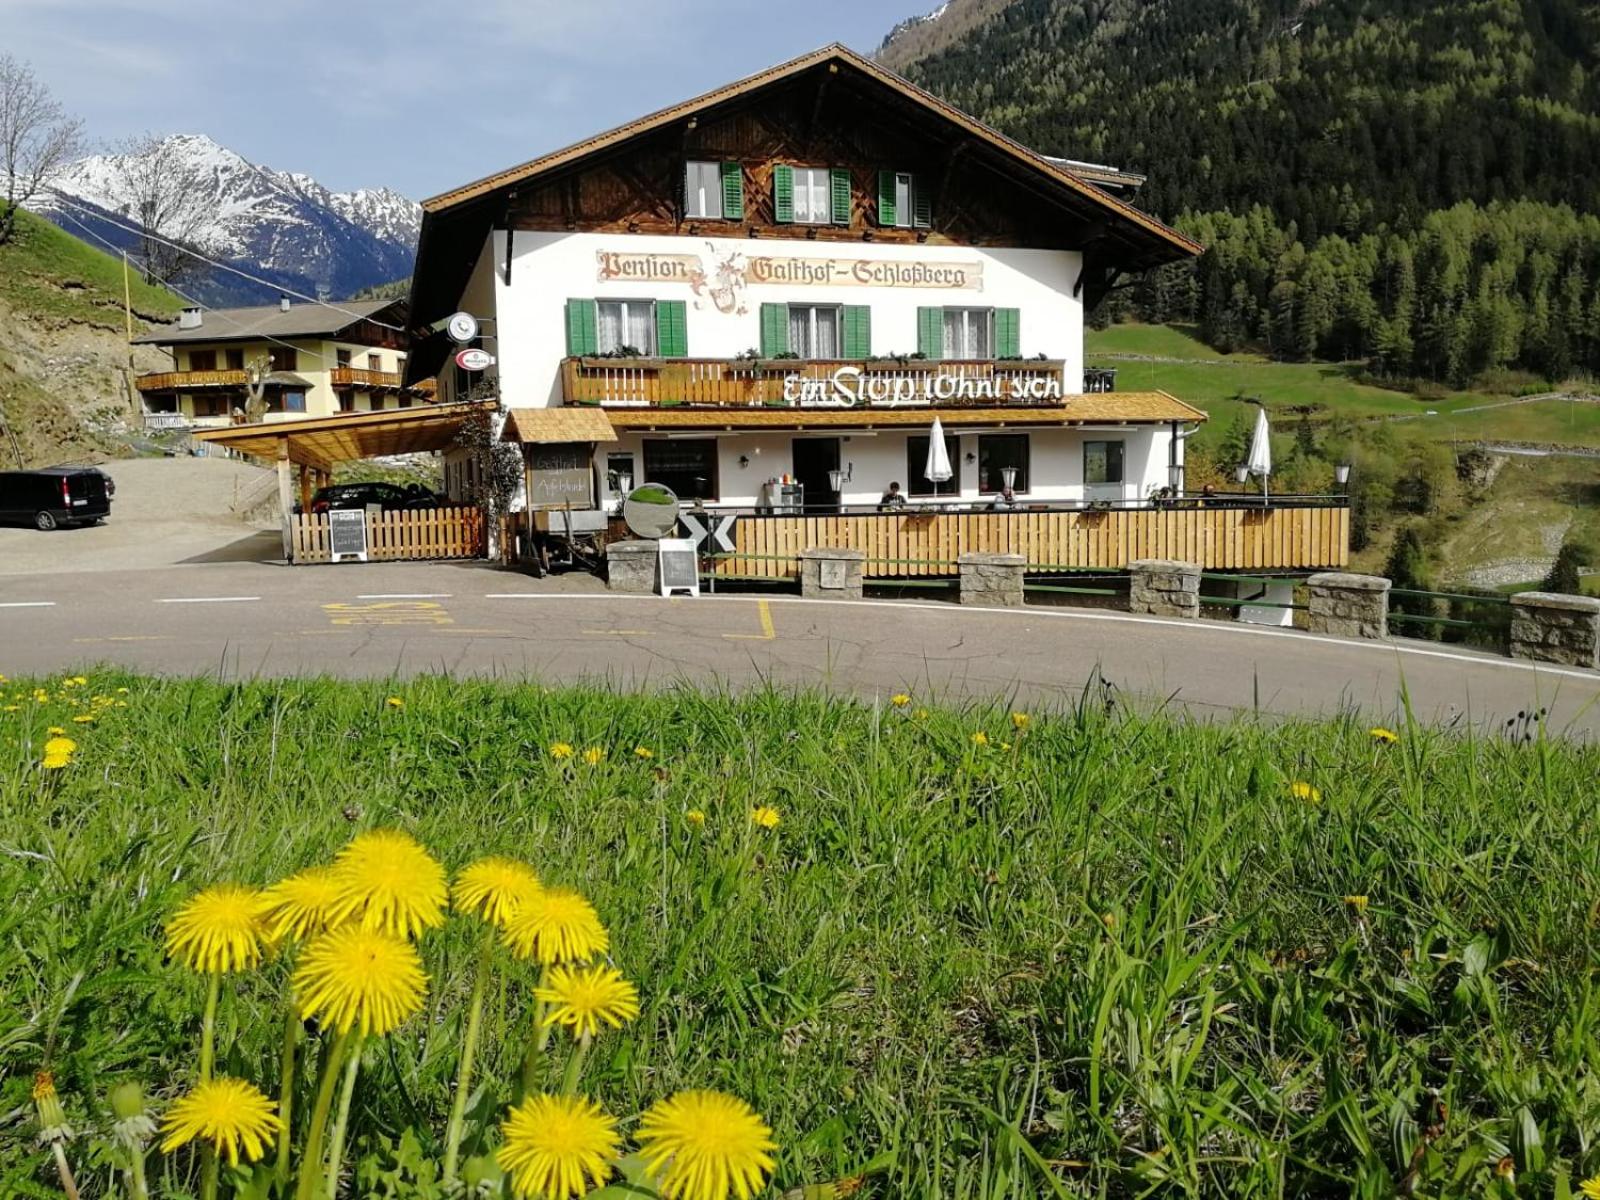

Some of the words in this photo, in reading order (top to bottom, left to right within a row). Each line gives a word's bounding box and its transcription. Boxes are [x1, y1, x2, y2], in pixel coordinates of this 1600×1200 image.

[600, 252, 689, 280] Pension
[783, 372, 831, 402] Ein
[833, 366, 915, 408] Stop
[1009, 371, 1061, 400] sich
